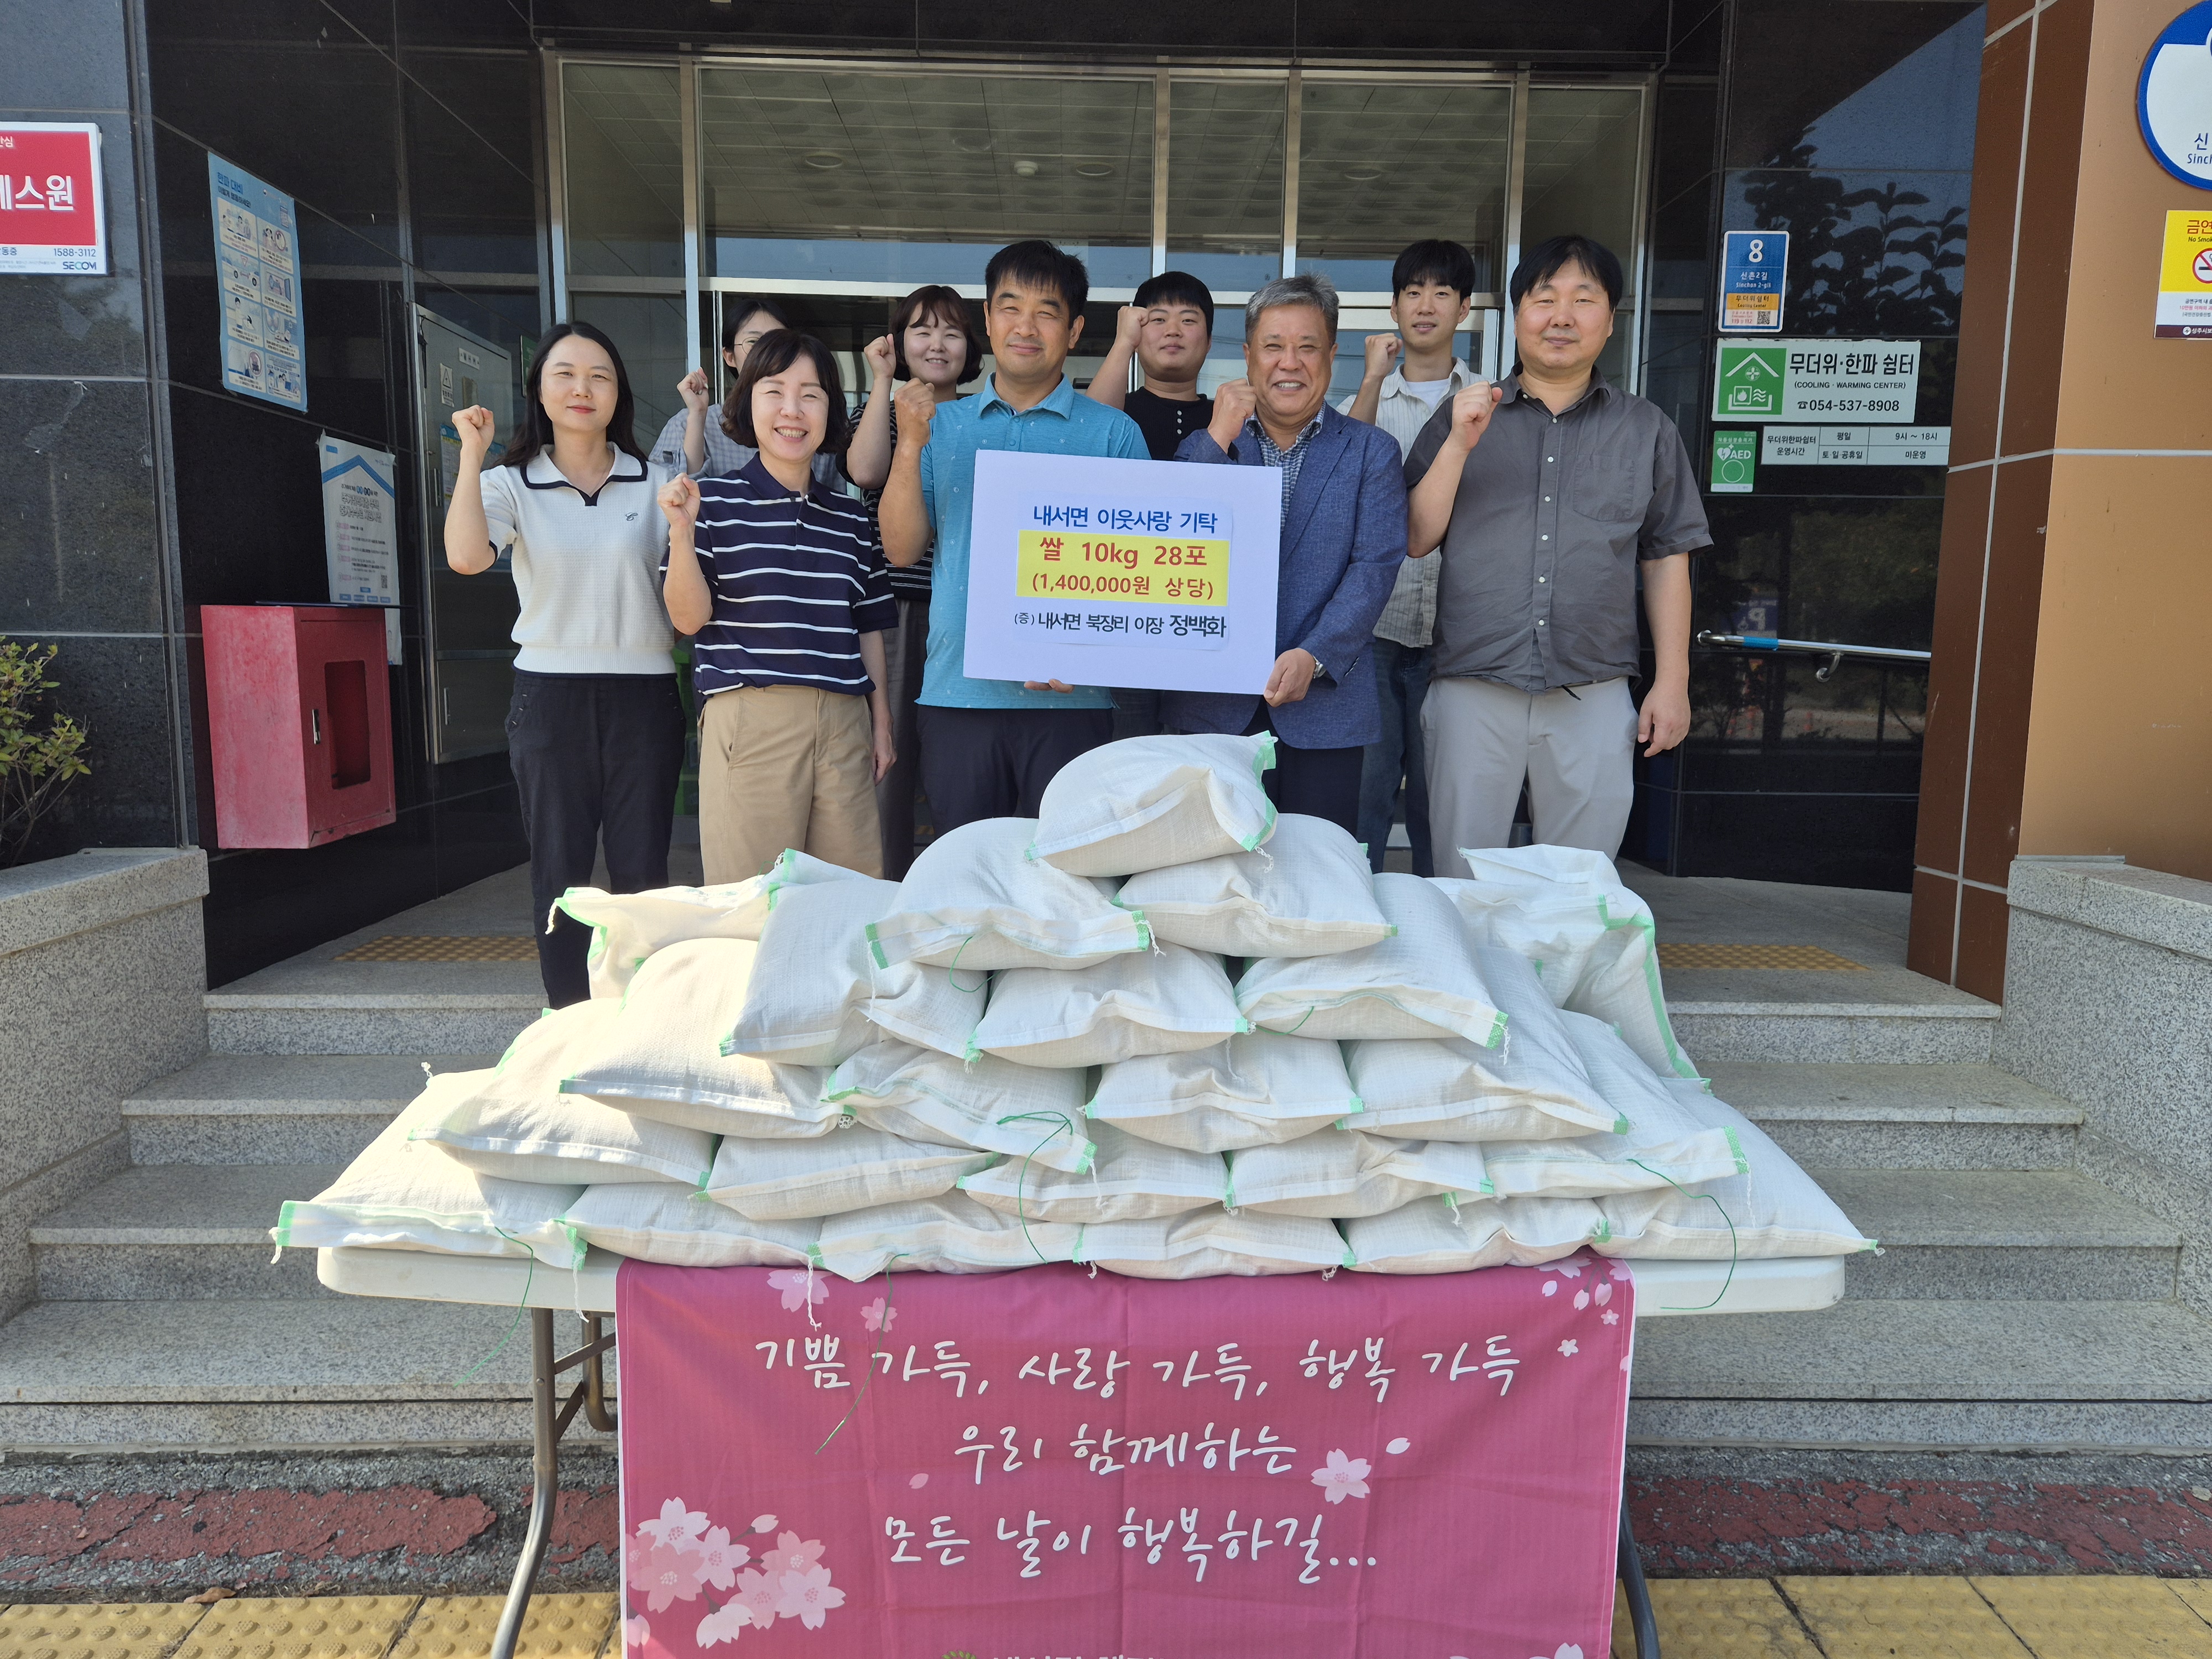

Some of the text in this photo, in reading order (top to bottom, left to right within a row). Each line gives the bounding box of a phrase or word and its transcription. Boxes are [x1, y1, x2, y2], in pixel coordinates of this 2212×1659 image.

[0, 247, 96, 257] 동중 1588-3112
[1748, 239, 1764, 263] 8
[62, 261, 97, 270] SECOM
[1740, 272, 1768, 280] 신촌2길
[1883, 353, 1914, 375] 쉼터
[1809, 400, 1900, 411] 054-537-8908
[1767, 435, 1816, 444] 무더위한파쉼터
[1837, 432, 1851, 441] 평일
[1895, 432, 1907, 441] 9시
[1921, 432, 1938, 441] 18시
[1730, 450, 1752, 460] AED
[1777, 447, 1805, 456] 운영시간
[1905, 451, 1927, 459] 미운영
[1033, 504, 1218, 534] 내서면 이웃사랑 기탁
[1039, 536, 1207, 570] 쌀 10kg 28포
[1032, 572, 1214, 600] (1,400,000원 상당)
[1014, 612, 1227, 638] (증) 내서면 북장리 이장 정백화
[755, 1333, 1521, 1403] 기쁨 가득, 사랑 가득, 행복 가득
[954, 1422, 1297, 1485] 우리 함께하는
[885, 1506, 1377, 1585] 모든 날이 행복하길...
